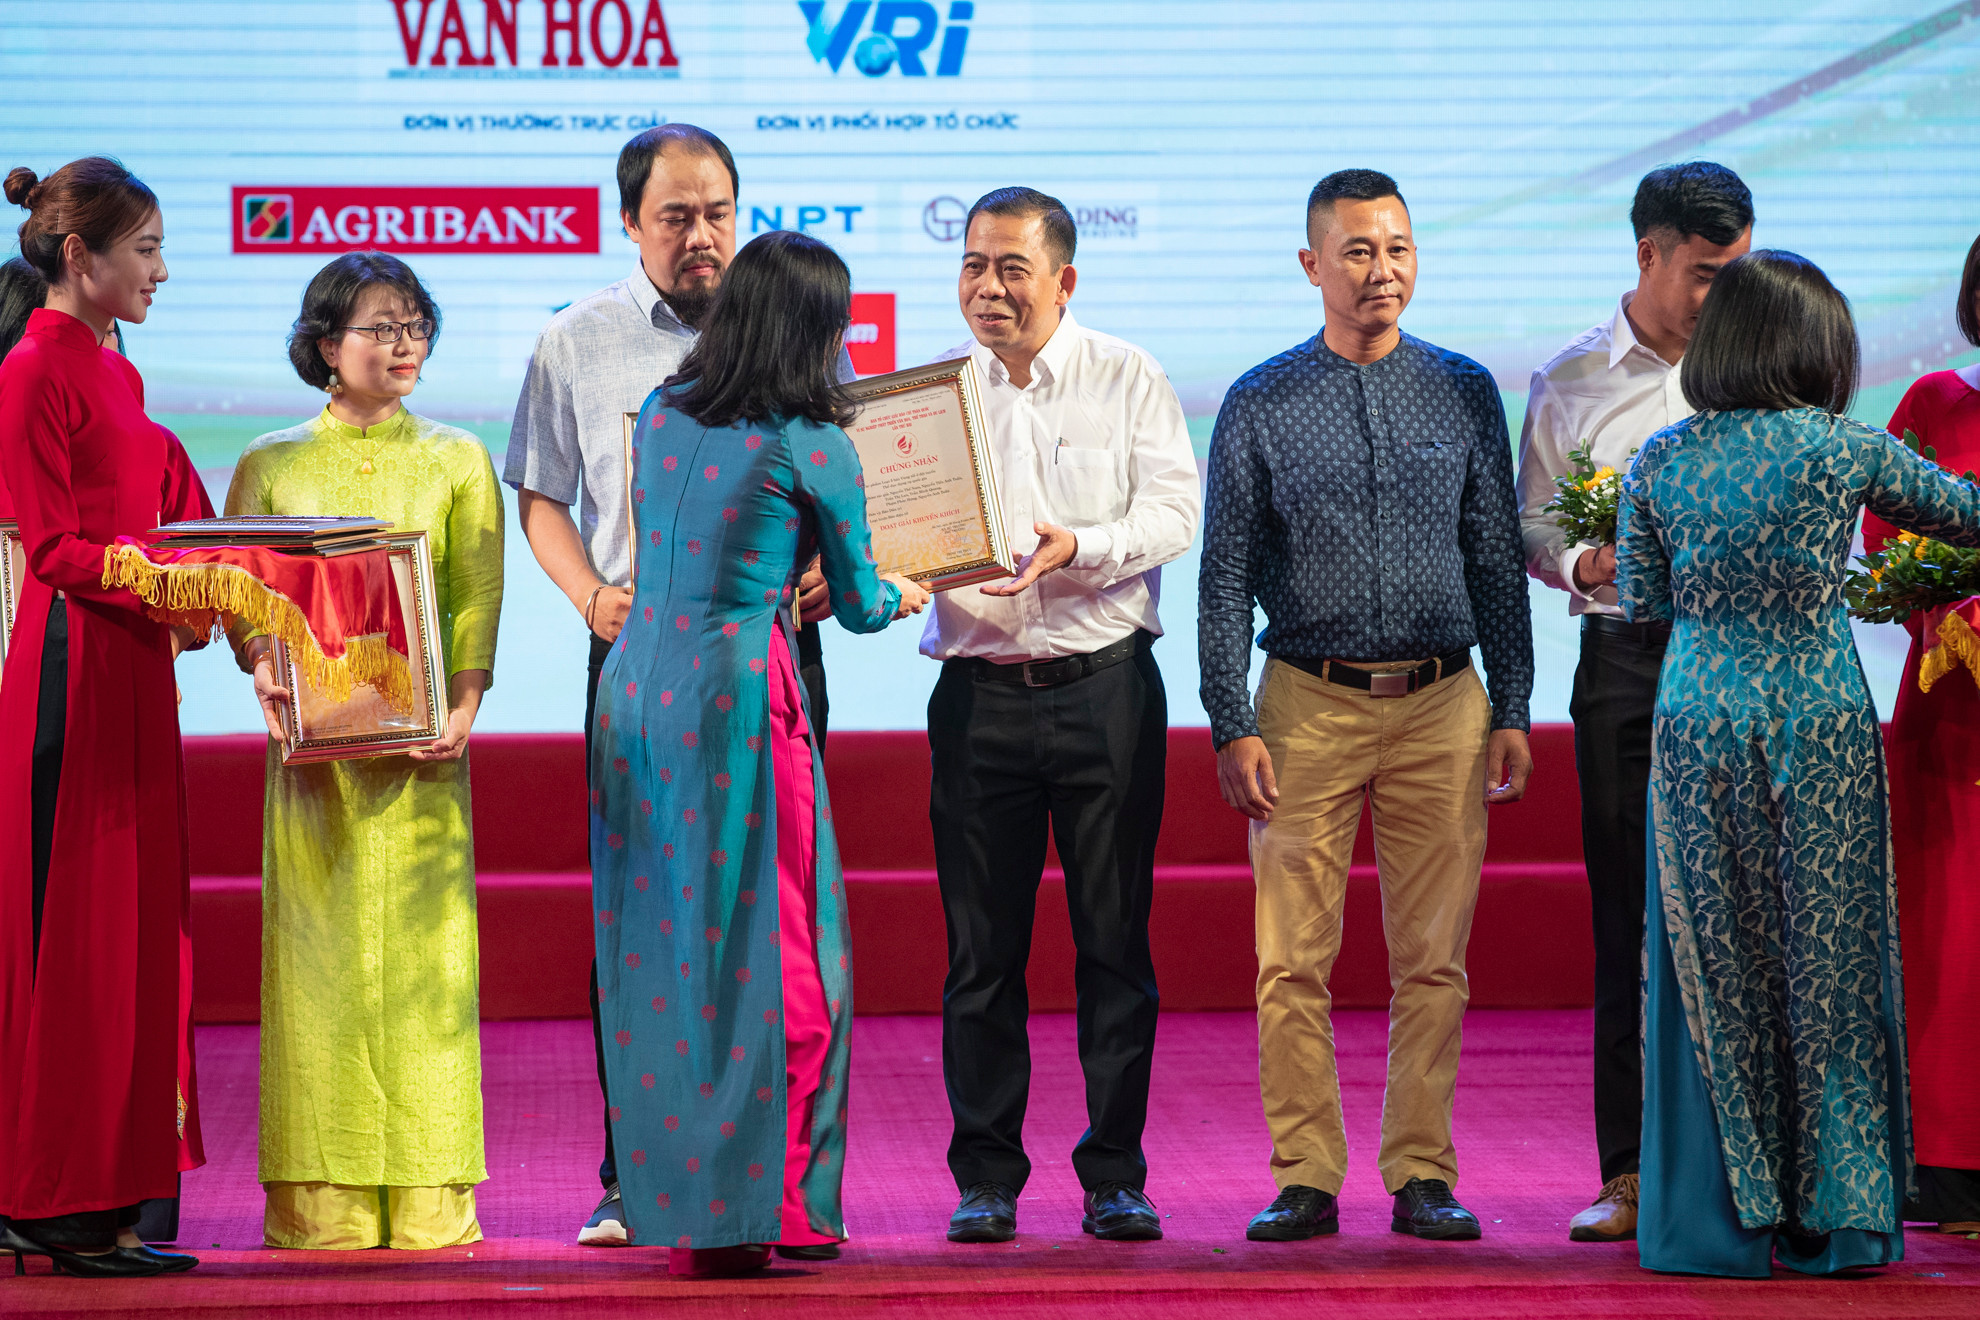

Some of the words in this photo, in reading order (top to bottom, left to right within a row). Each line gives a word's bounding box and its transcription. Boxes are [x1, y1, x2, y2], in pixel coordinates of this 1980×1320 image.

[300, 205, 582, 244] AGRIBANK
[737, 206, 862, 232] NPT
[1076, 207, 1137, 226] DING
[880, 462, 912, 474] CHỨNG
[913, 455, 938, 467] NHẬN
[913, 512, 938, 524] KHUYẾN
[940, 508, 960, 517] KHÍCH
